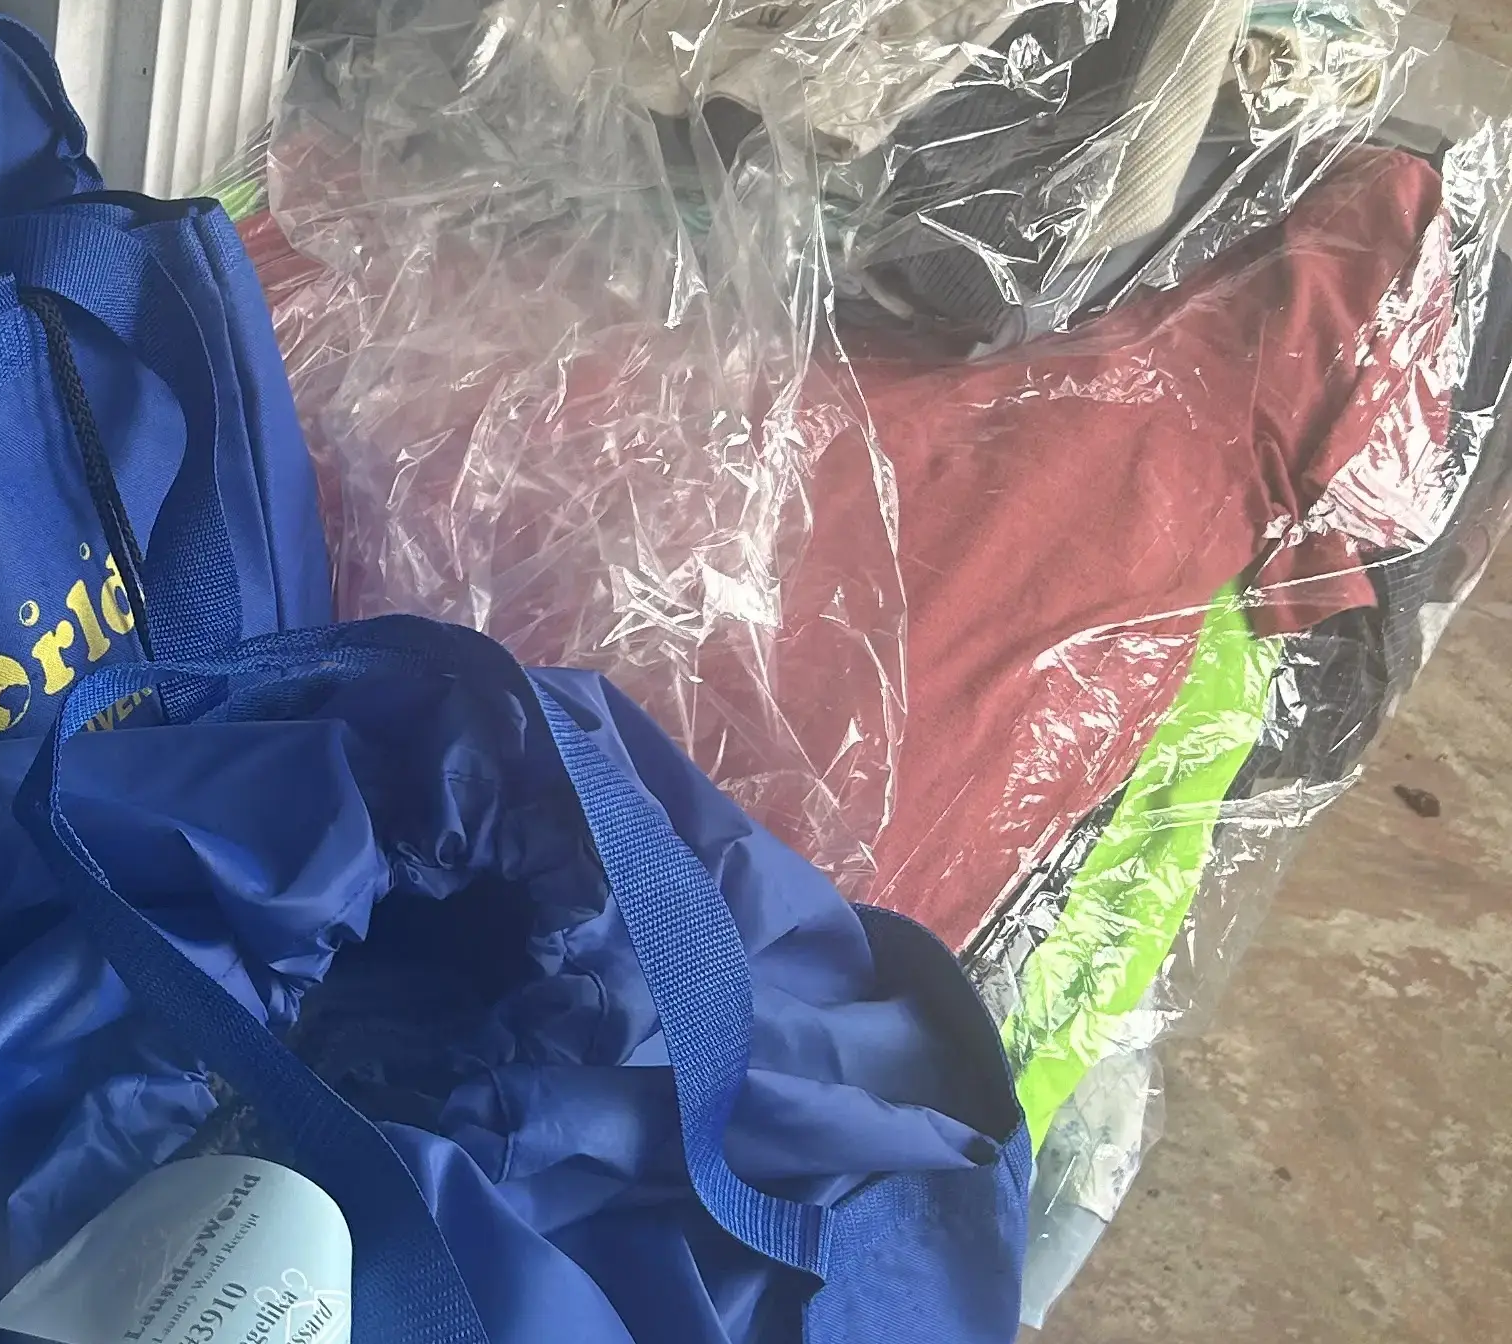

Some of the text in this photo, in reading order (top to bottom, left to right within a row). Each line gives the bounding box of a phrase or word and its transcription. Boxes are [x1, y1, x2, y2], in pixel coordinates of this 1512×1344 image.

[122, 1173, 262, 1340] LaundryWorld
[151, 1294, 198, 1344] Laundry
[190, 1254, 226, 1290] World
